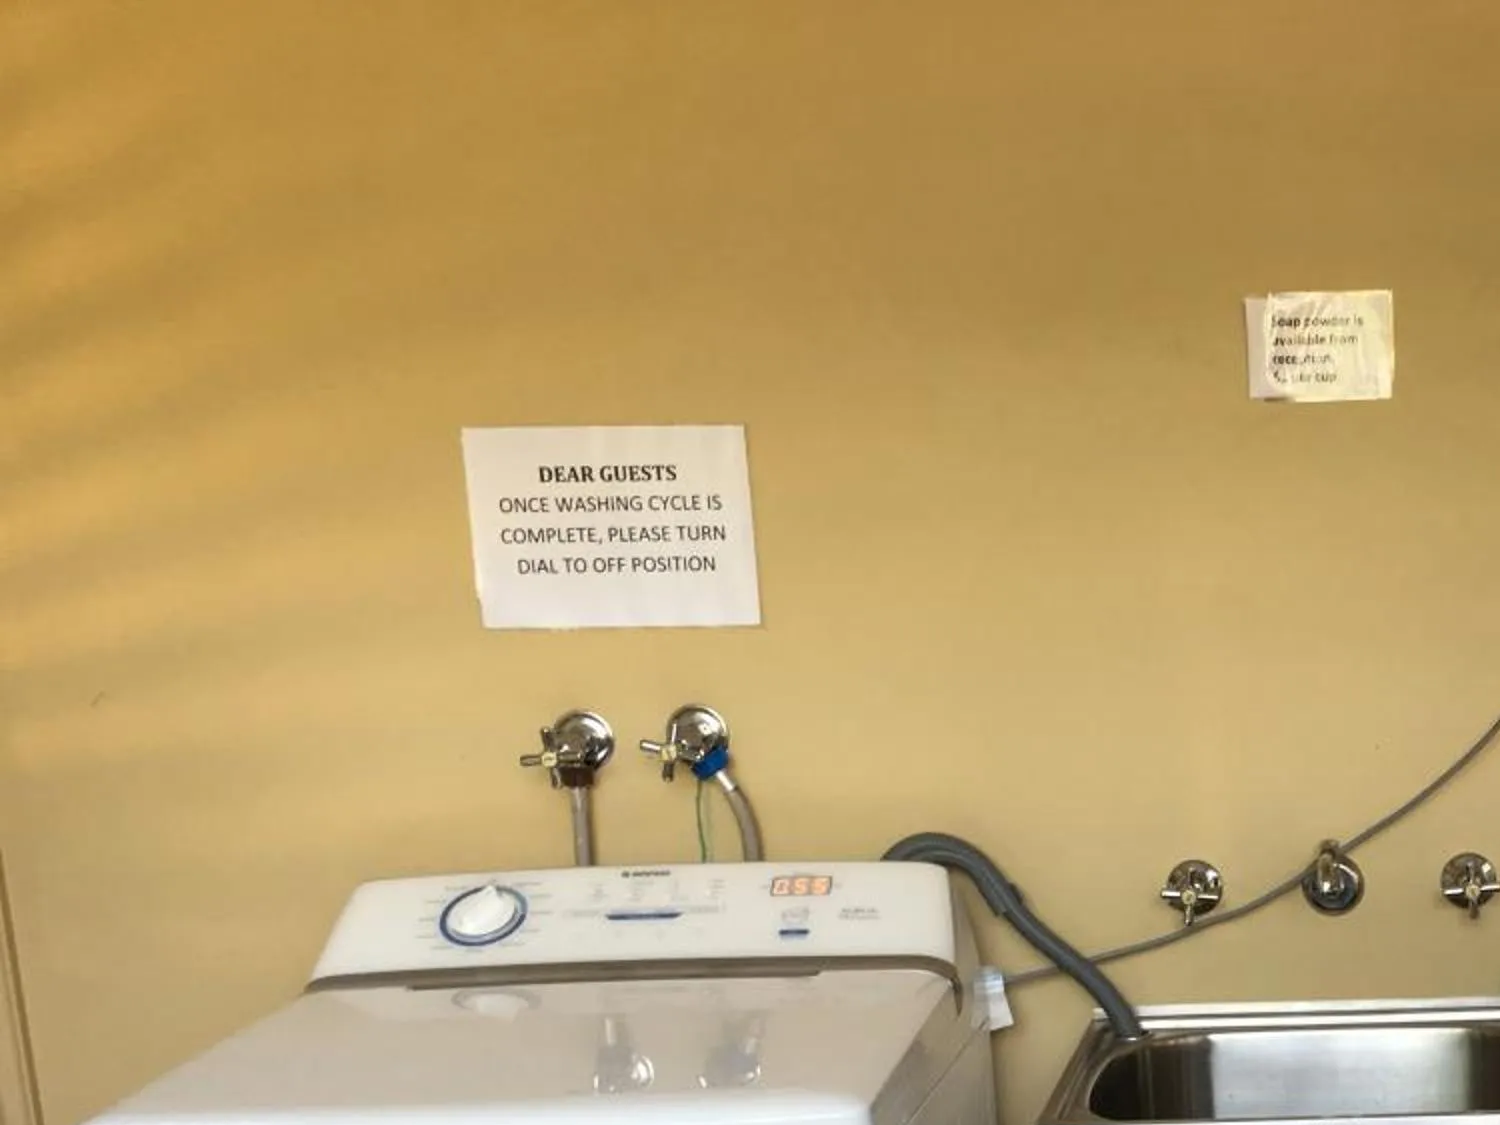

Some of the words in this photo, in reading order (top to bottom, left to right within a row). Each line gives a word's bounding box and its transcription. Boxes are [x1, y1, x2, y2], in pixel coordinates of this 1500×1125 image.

[538, 465, 594, 483] DEAR
[599, 464, 678, 482] GUESTS
[499, 496, 550, 513] ONCE
[555, 495, 644, 513] WASHING
[649, 494, 701, 512] CYCLE
[706, 494, 722, 511] IS
[500, 526, 603, 546] COMPLETE,
[607, 525, 671, 543] PLEASE
[675, 524, 727, 541] TURN
[517, 558, 559, 575] DIAL
[564, 556, 587, 574] TO
[593, 556, 626, 573] OFF
[631, 555, 716, 573] POSITION
